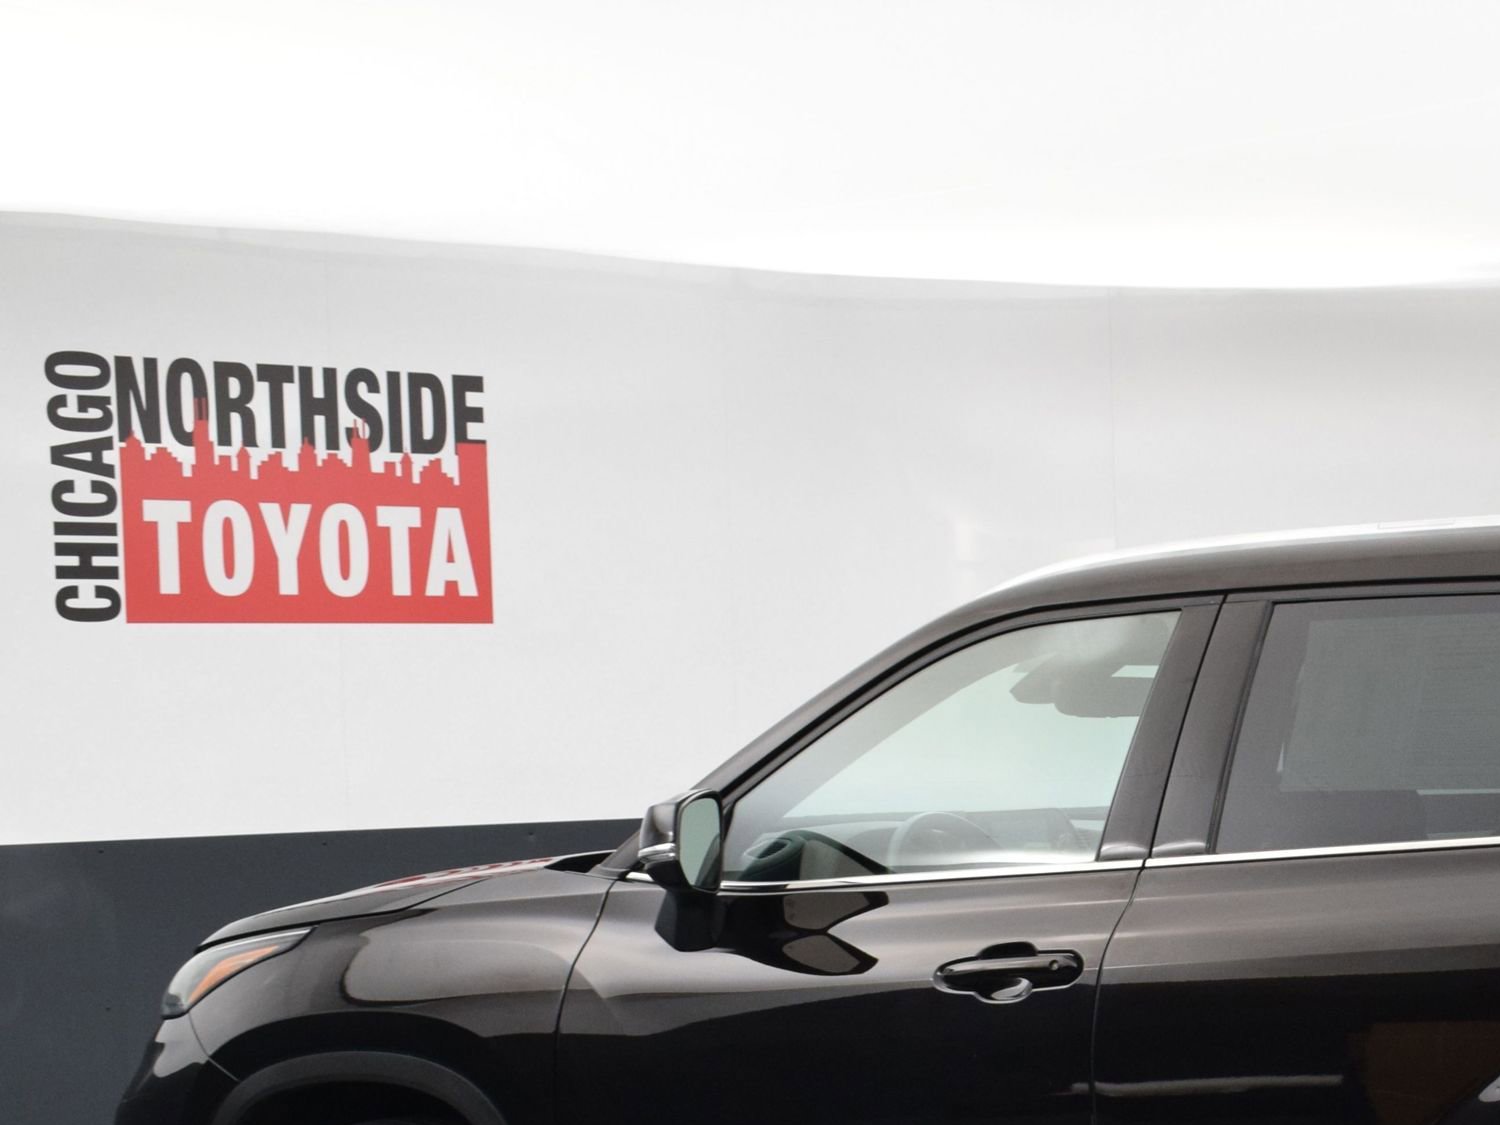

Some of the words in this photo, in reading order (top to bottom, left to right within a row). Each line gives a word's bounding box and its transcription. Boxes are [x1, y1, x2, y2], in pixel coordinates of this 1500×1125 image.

[114, 355, 487, 455] NORTHSIDE
[44, 350, 121, 622] CHICAGO
[142, 500, 478, 597] TOYOTA
